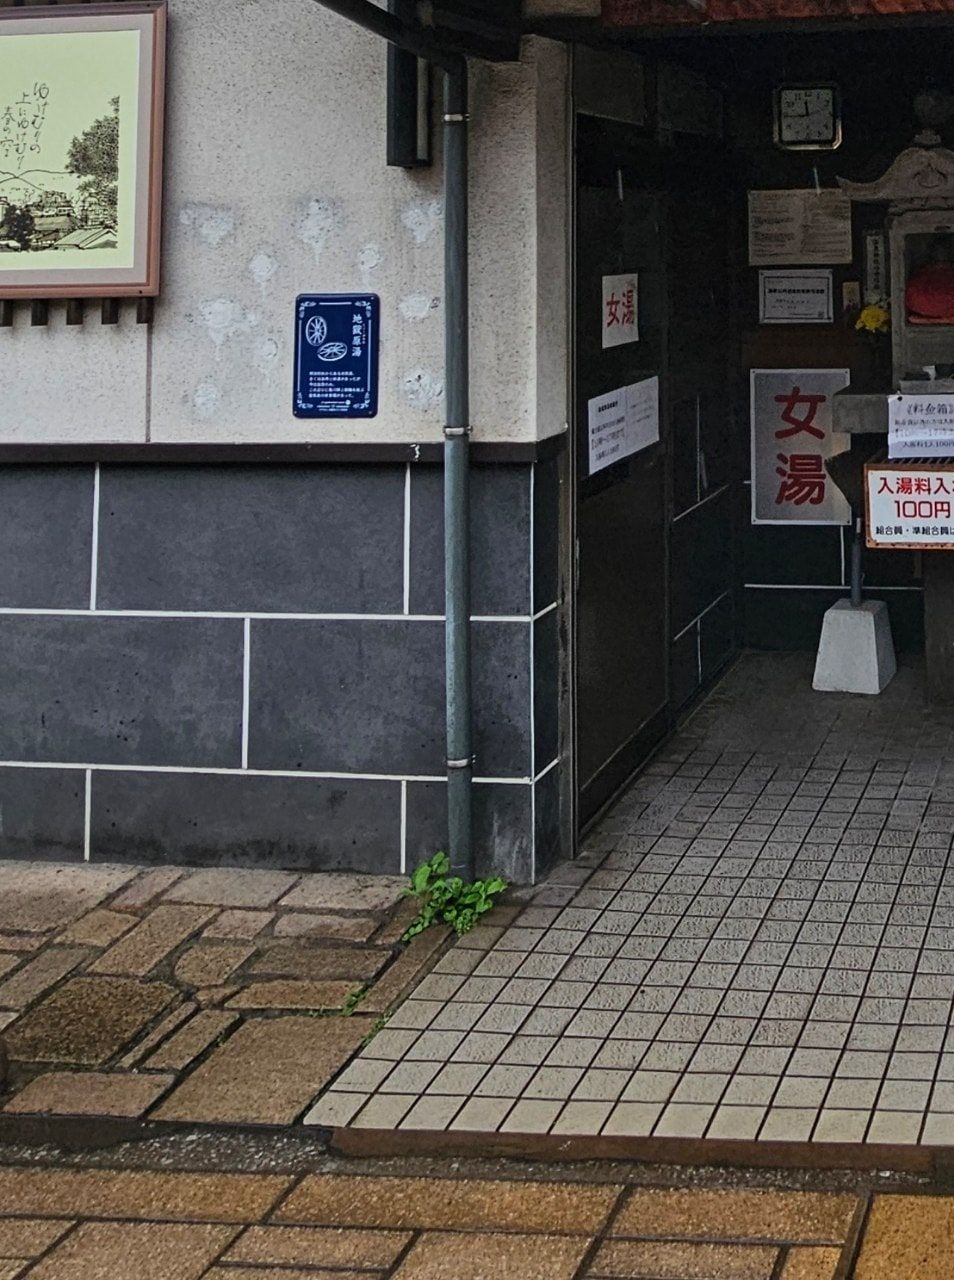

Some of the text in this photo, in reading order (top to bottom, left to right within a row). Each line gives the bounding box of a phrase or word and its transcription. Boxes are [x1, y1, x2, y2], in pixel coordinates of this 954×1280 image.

[606, 289, 635, 328] 女湯
[775, 385, 827, 506] 女湯
[894, 500, 951, 519] 100円
